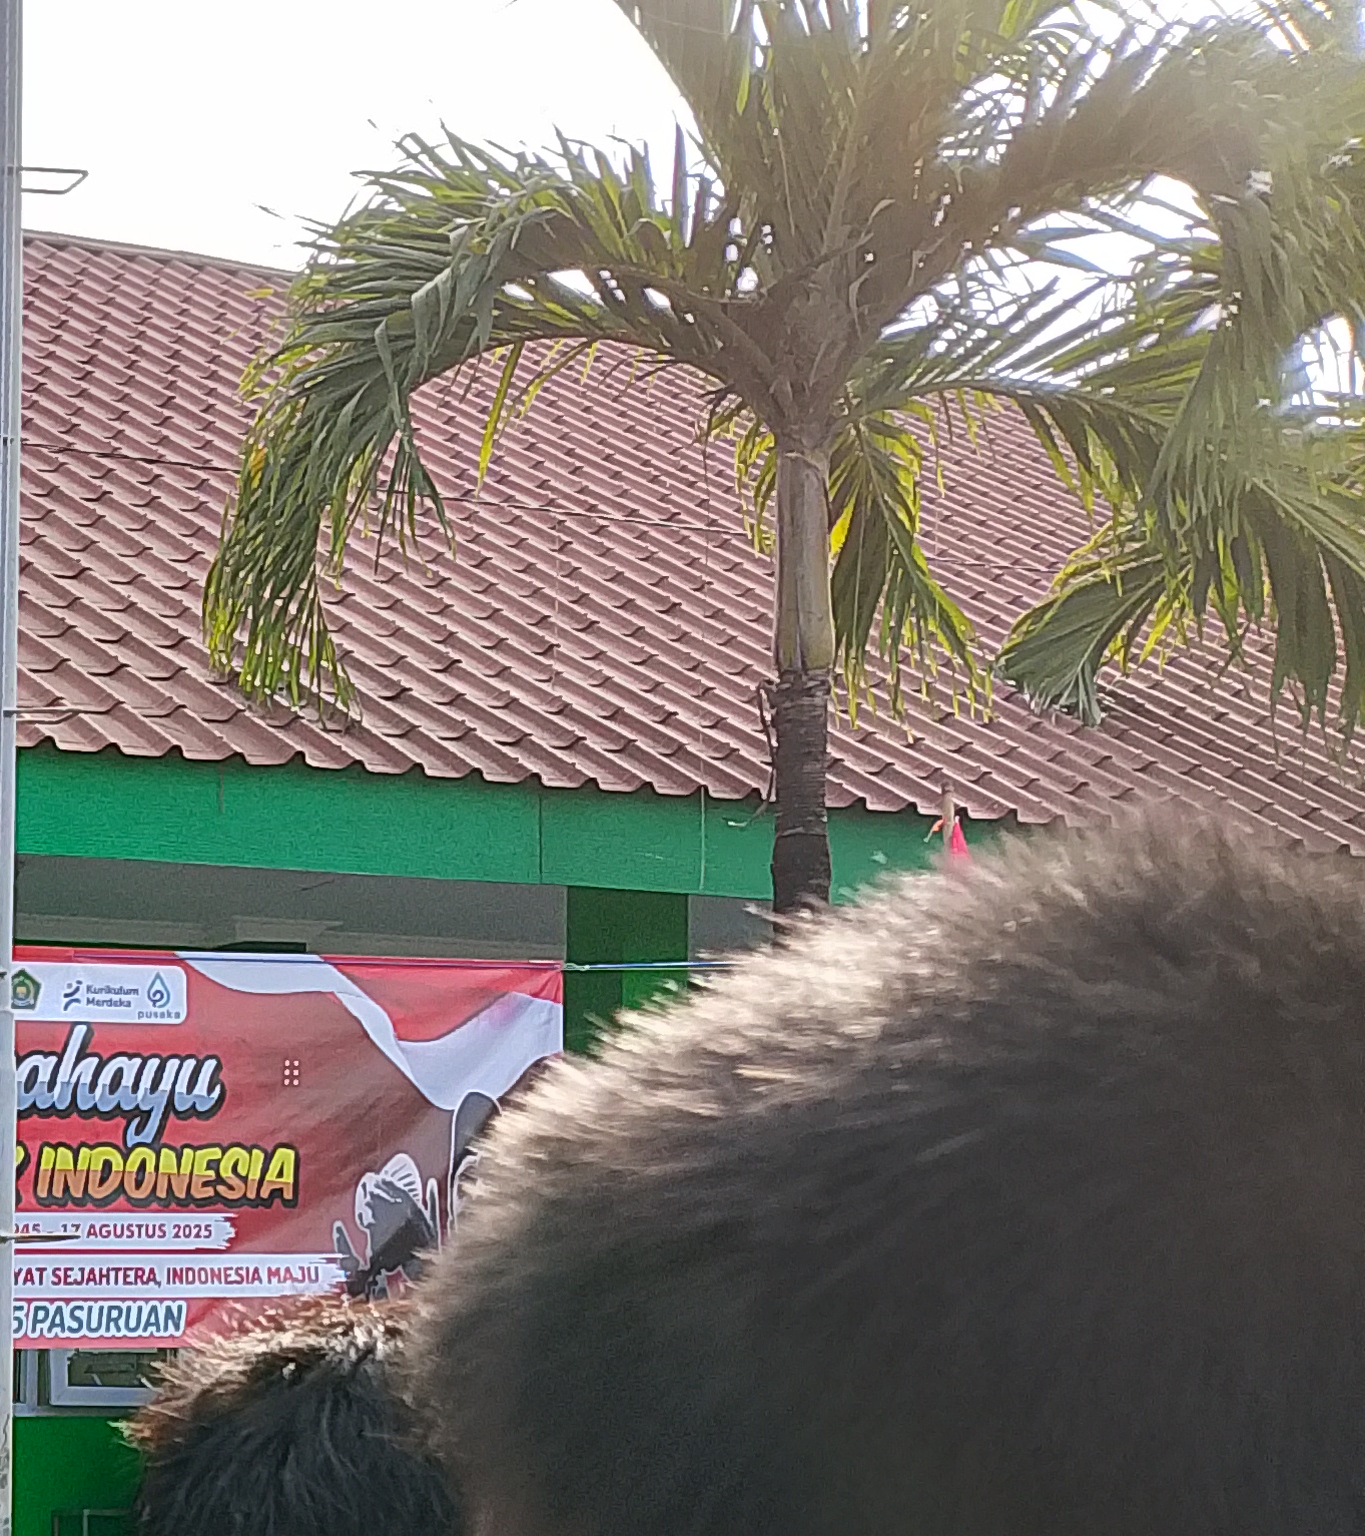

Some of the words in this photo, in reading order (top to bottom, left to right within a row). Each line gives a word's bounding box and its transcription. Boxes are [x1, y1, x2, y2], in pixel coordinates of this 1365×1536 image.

[86, 984, 139, 996] Kurikulum
[86, 997, 132, 1008] Merdeka
[137, 1009, 181, 1020] pusaka
[36, 1144, 296, 1200] INDONESIA
[86, 1223, 166, 1239] AGUSTUS
[172, 1223, 212, 1239] 2025
[14, 1267, 47, 1286] YAT
[51, 1266, 162, 1289] SEJAHTERA,
[166, 1266, 262, 1286] INDONESIA
[267, 1265, 319, 1285] MAJU
[31, 1304, 183, 1335] PASURUAN
